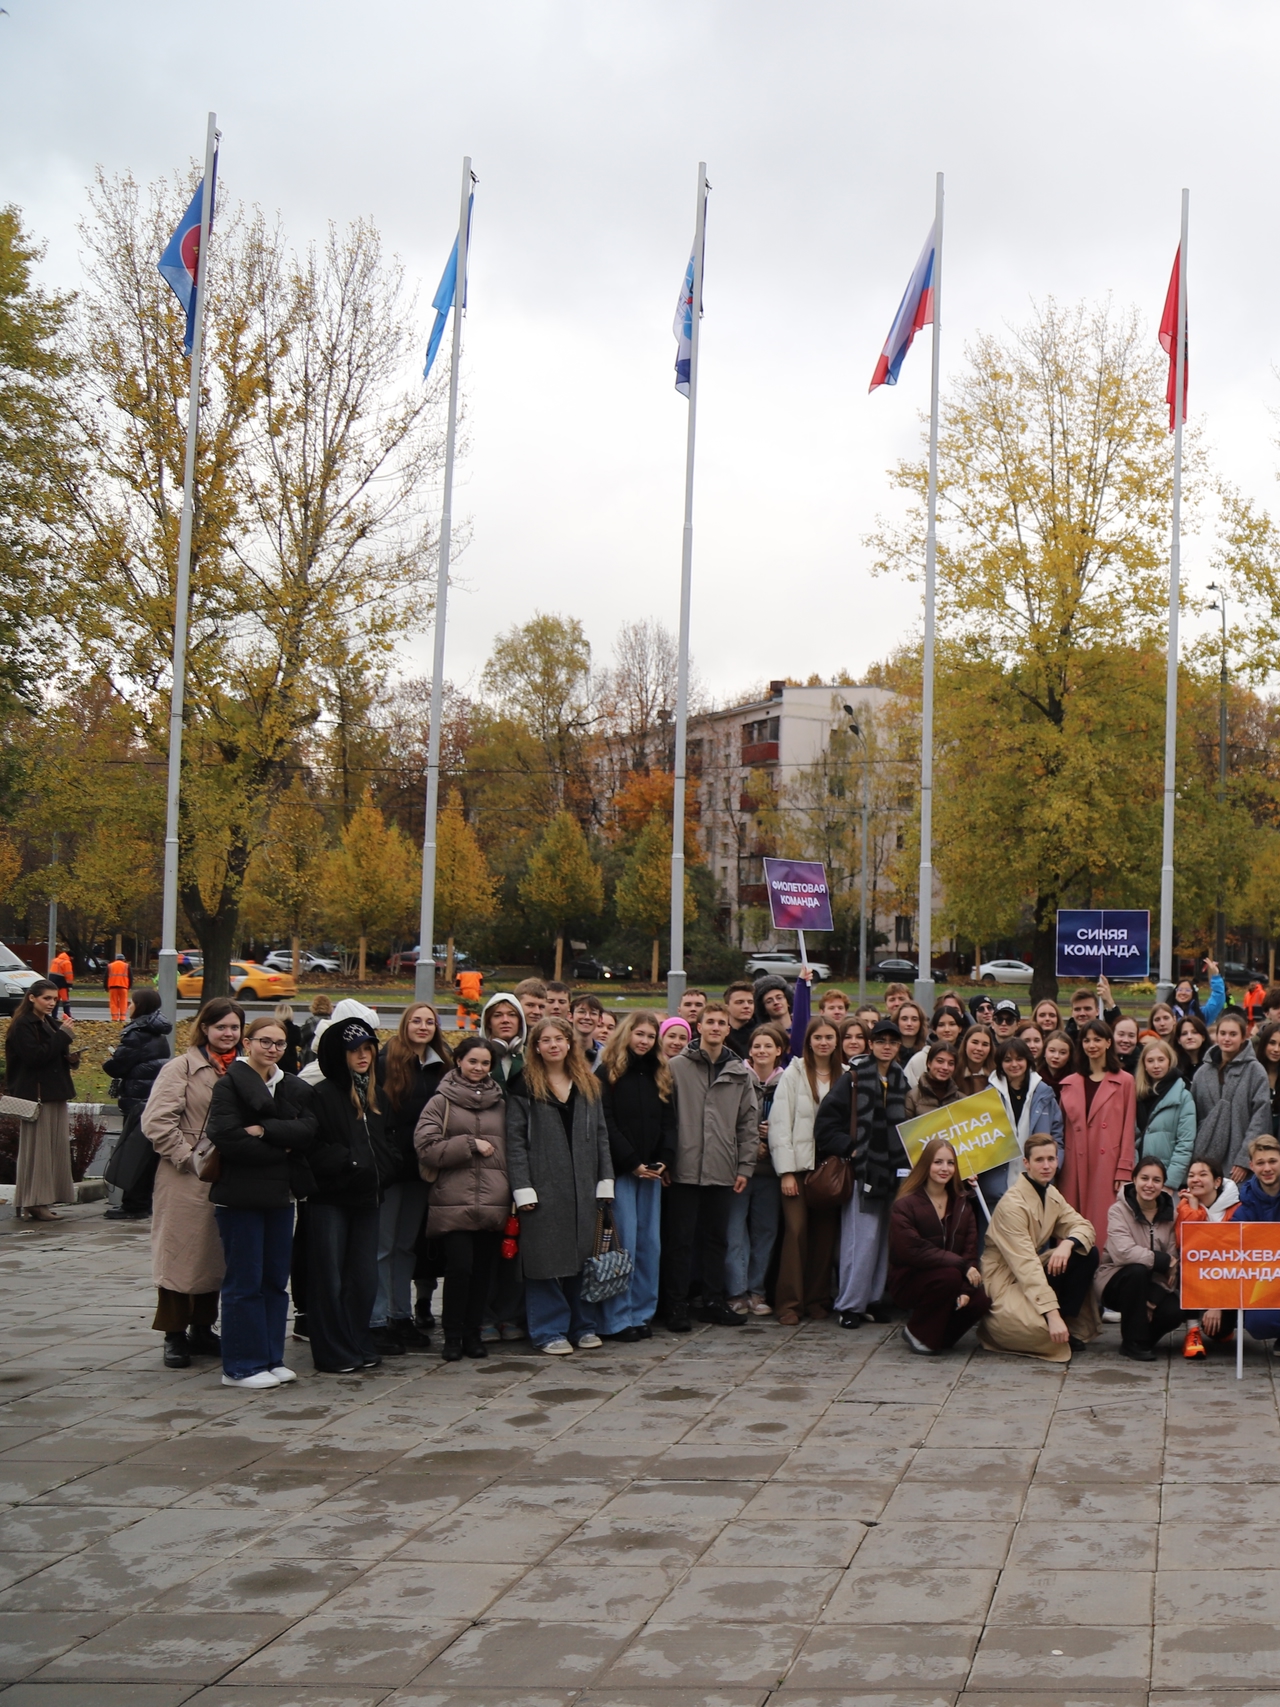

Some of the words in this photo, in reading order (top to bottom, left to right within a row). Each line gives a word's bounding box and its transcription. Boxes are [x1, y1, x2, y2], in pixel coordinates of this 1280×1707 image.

[772, 881, 826, 893] ФИОЛЕТОВАЯ
[780, 895, 820, 908] КОМАНДА
[1077, 928, 1128, 940] СИНЯЯ
[1064, 944, 1140, 958] КОМАНДА
[953, 1128, 1006, 1157] АНДА
